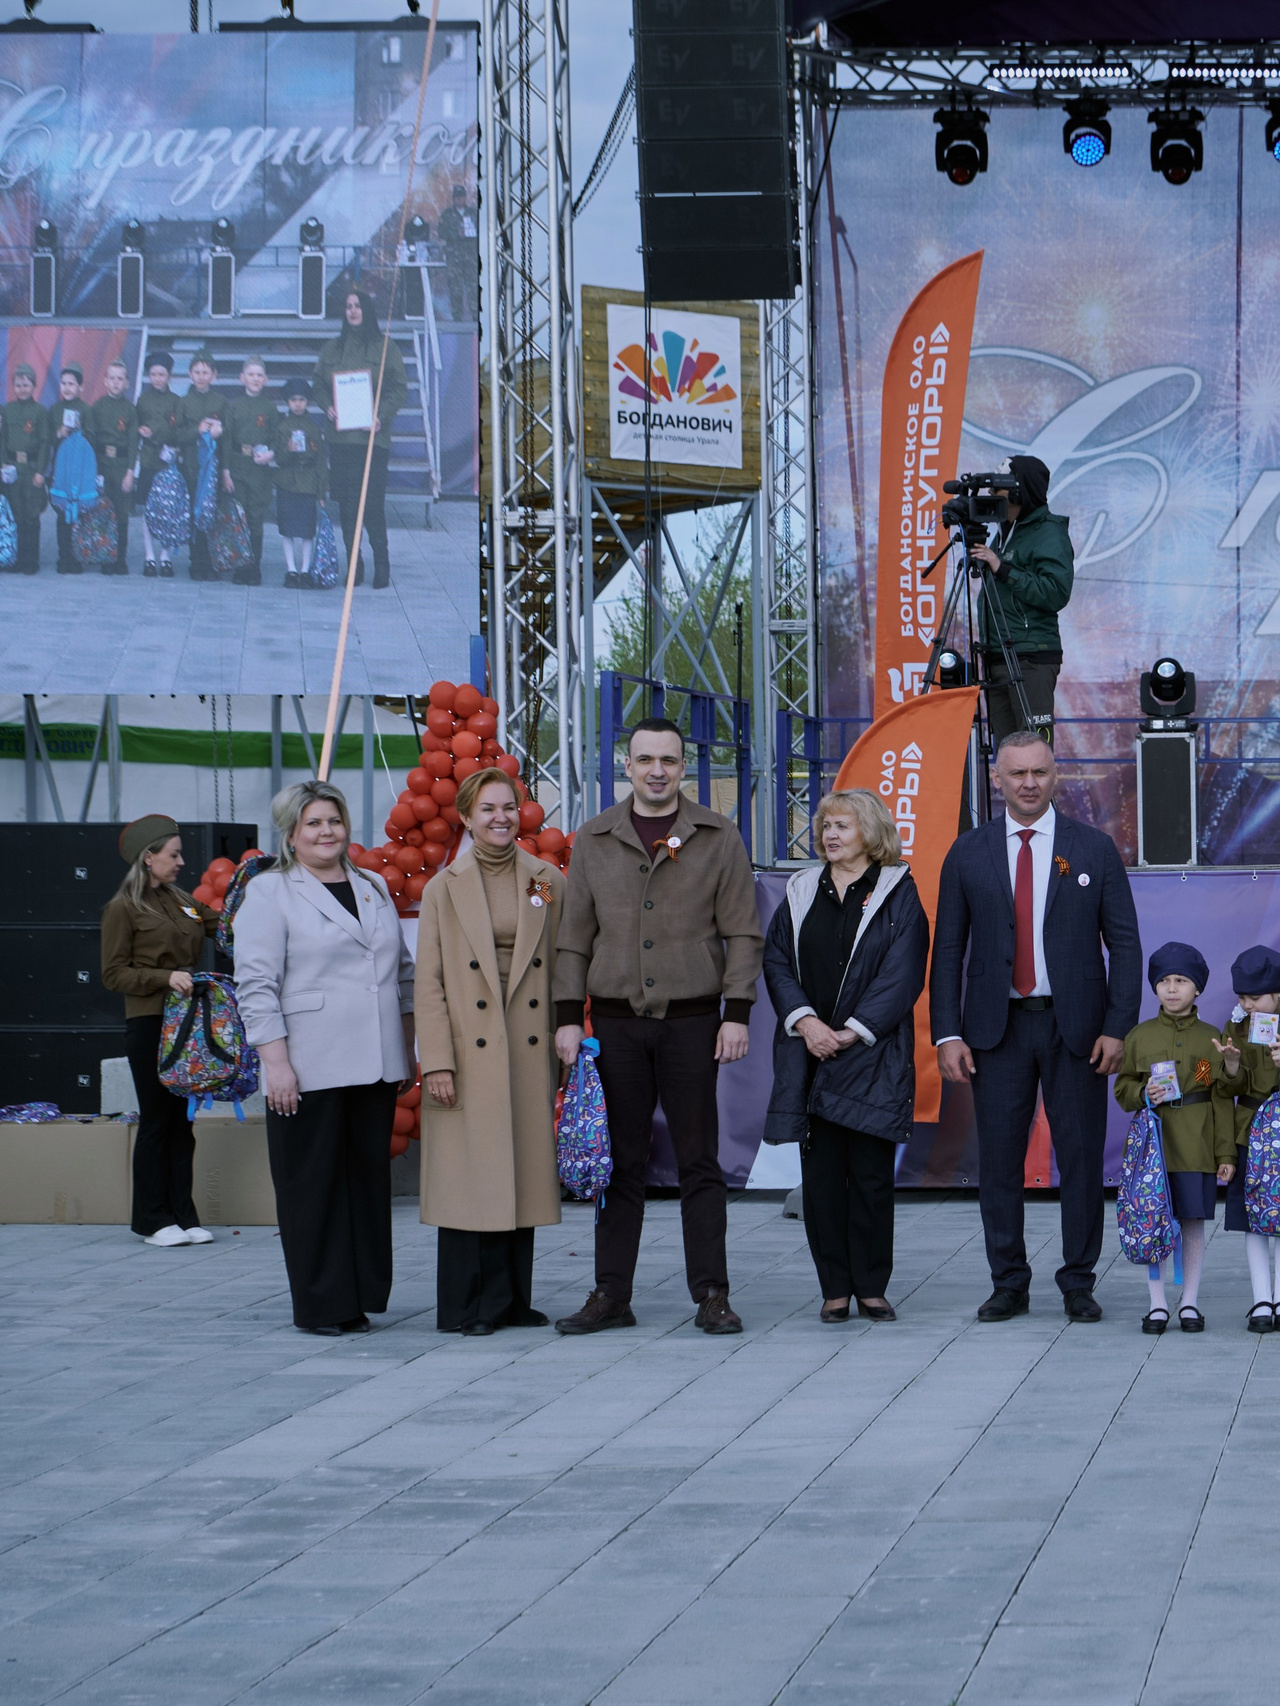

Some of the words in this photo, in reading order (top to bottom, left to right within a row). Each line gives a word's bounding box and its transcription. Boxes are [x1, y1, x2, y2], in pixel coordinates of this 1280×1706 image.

[909, 335, 926, 389] ОАО
[900, 403, 919, 636] БОГДАНОВИЧСКОЕ
[878, 750, 896, 796] ОАО
